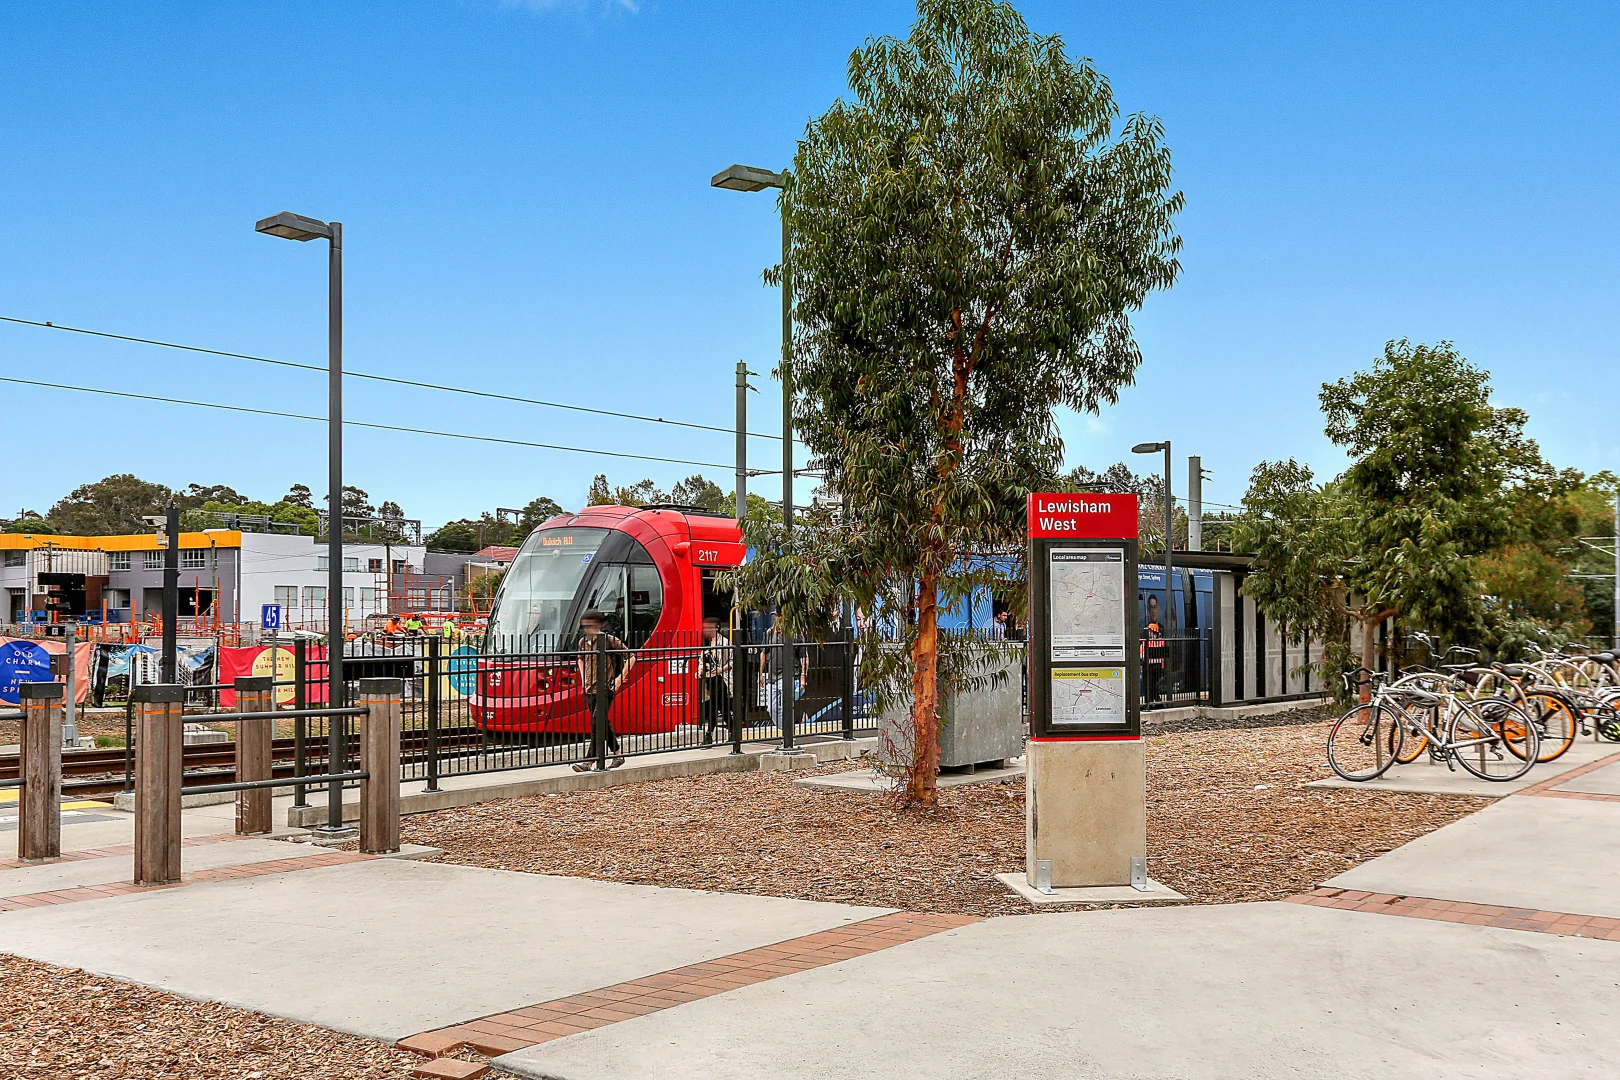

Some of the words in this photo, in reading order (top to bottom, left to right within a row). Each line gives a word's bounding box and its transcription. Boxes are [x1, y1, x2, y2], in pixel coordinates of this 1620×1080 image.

[1039, 499, 1111, 513] Lewisham
[1039, 517, 1077, 531] West
[564, 536, 573, 545] Hill
[698, 549, 718, 562] 2117
[265, 606, 277, 627] 45
[14, 650, 34, 658] OLD
[5, 657, 41, 666] CHARM
